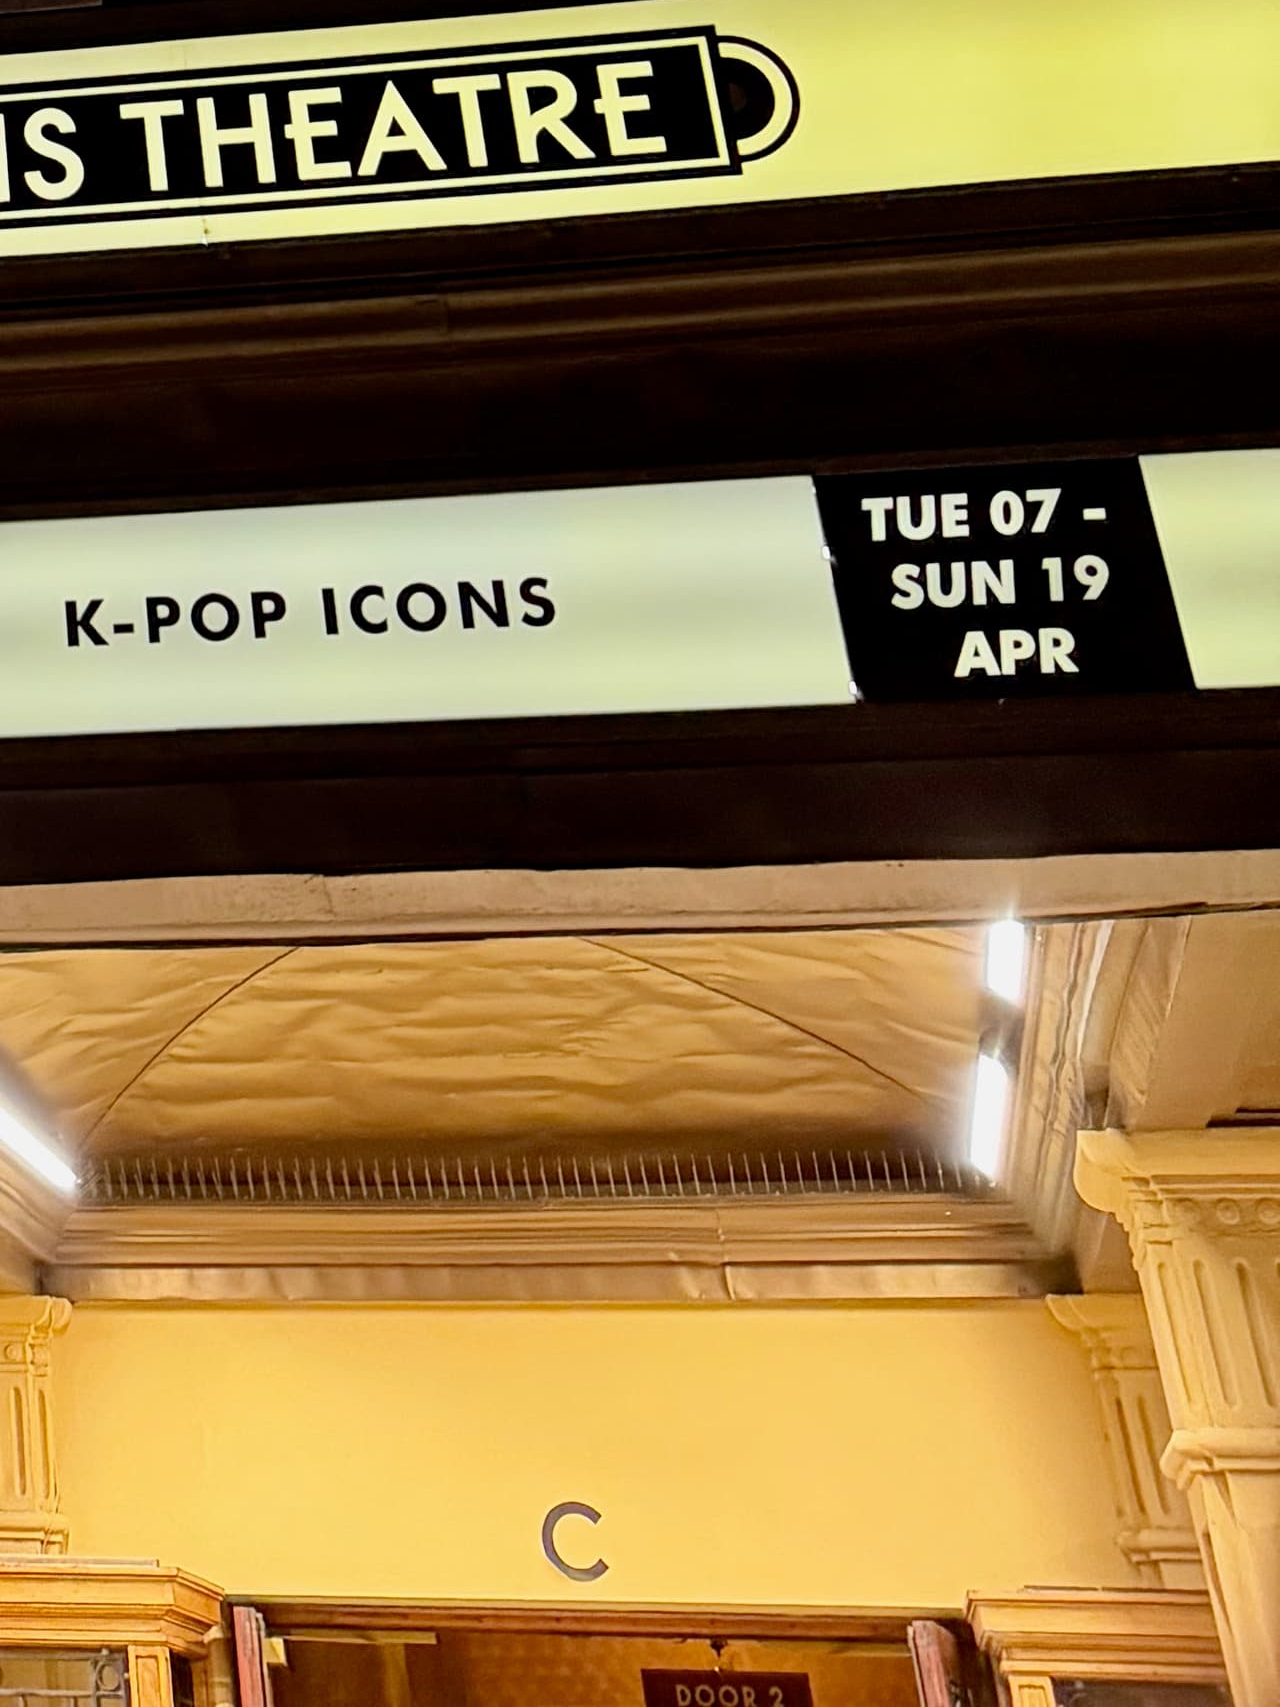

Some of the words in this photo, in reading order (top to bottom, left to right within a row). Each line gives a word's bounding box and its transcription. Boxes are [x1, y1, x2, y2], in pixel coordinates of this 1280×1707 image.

[119, 61, 666, 191] THEATRE
[861, 492, 970, 542] TUE
[989, 488, 1062, 536] 07
[891, 559, 1016, 610] SUN
[1041, 554, 1110, 602] 19
[64, 591, 287, 647] K-POP
[321, 577, 556, 636] ICONS
[954, 627, 1080, 678] APR
[541, 1500, 609, 1582] C
[676, 1684, 757, 1707] DOOR
[768, 1686, 785, 1707] 2
